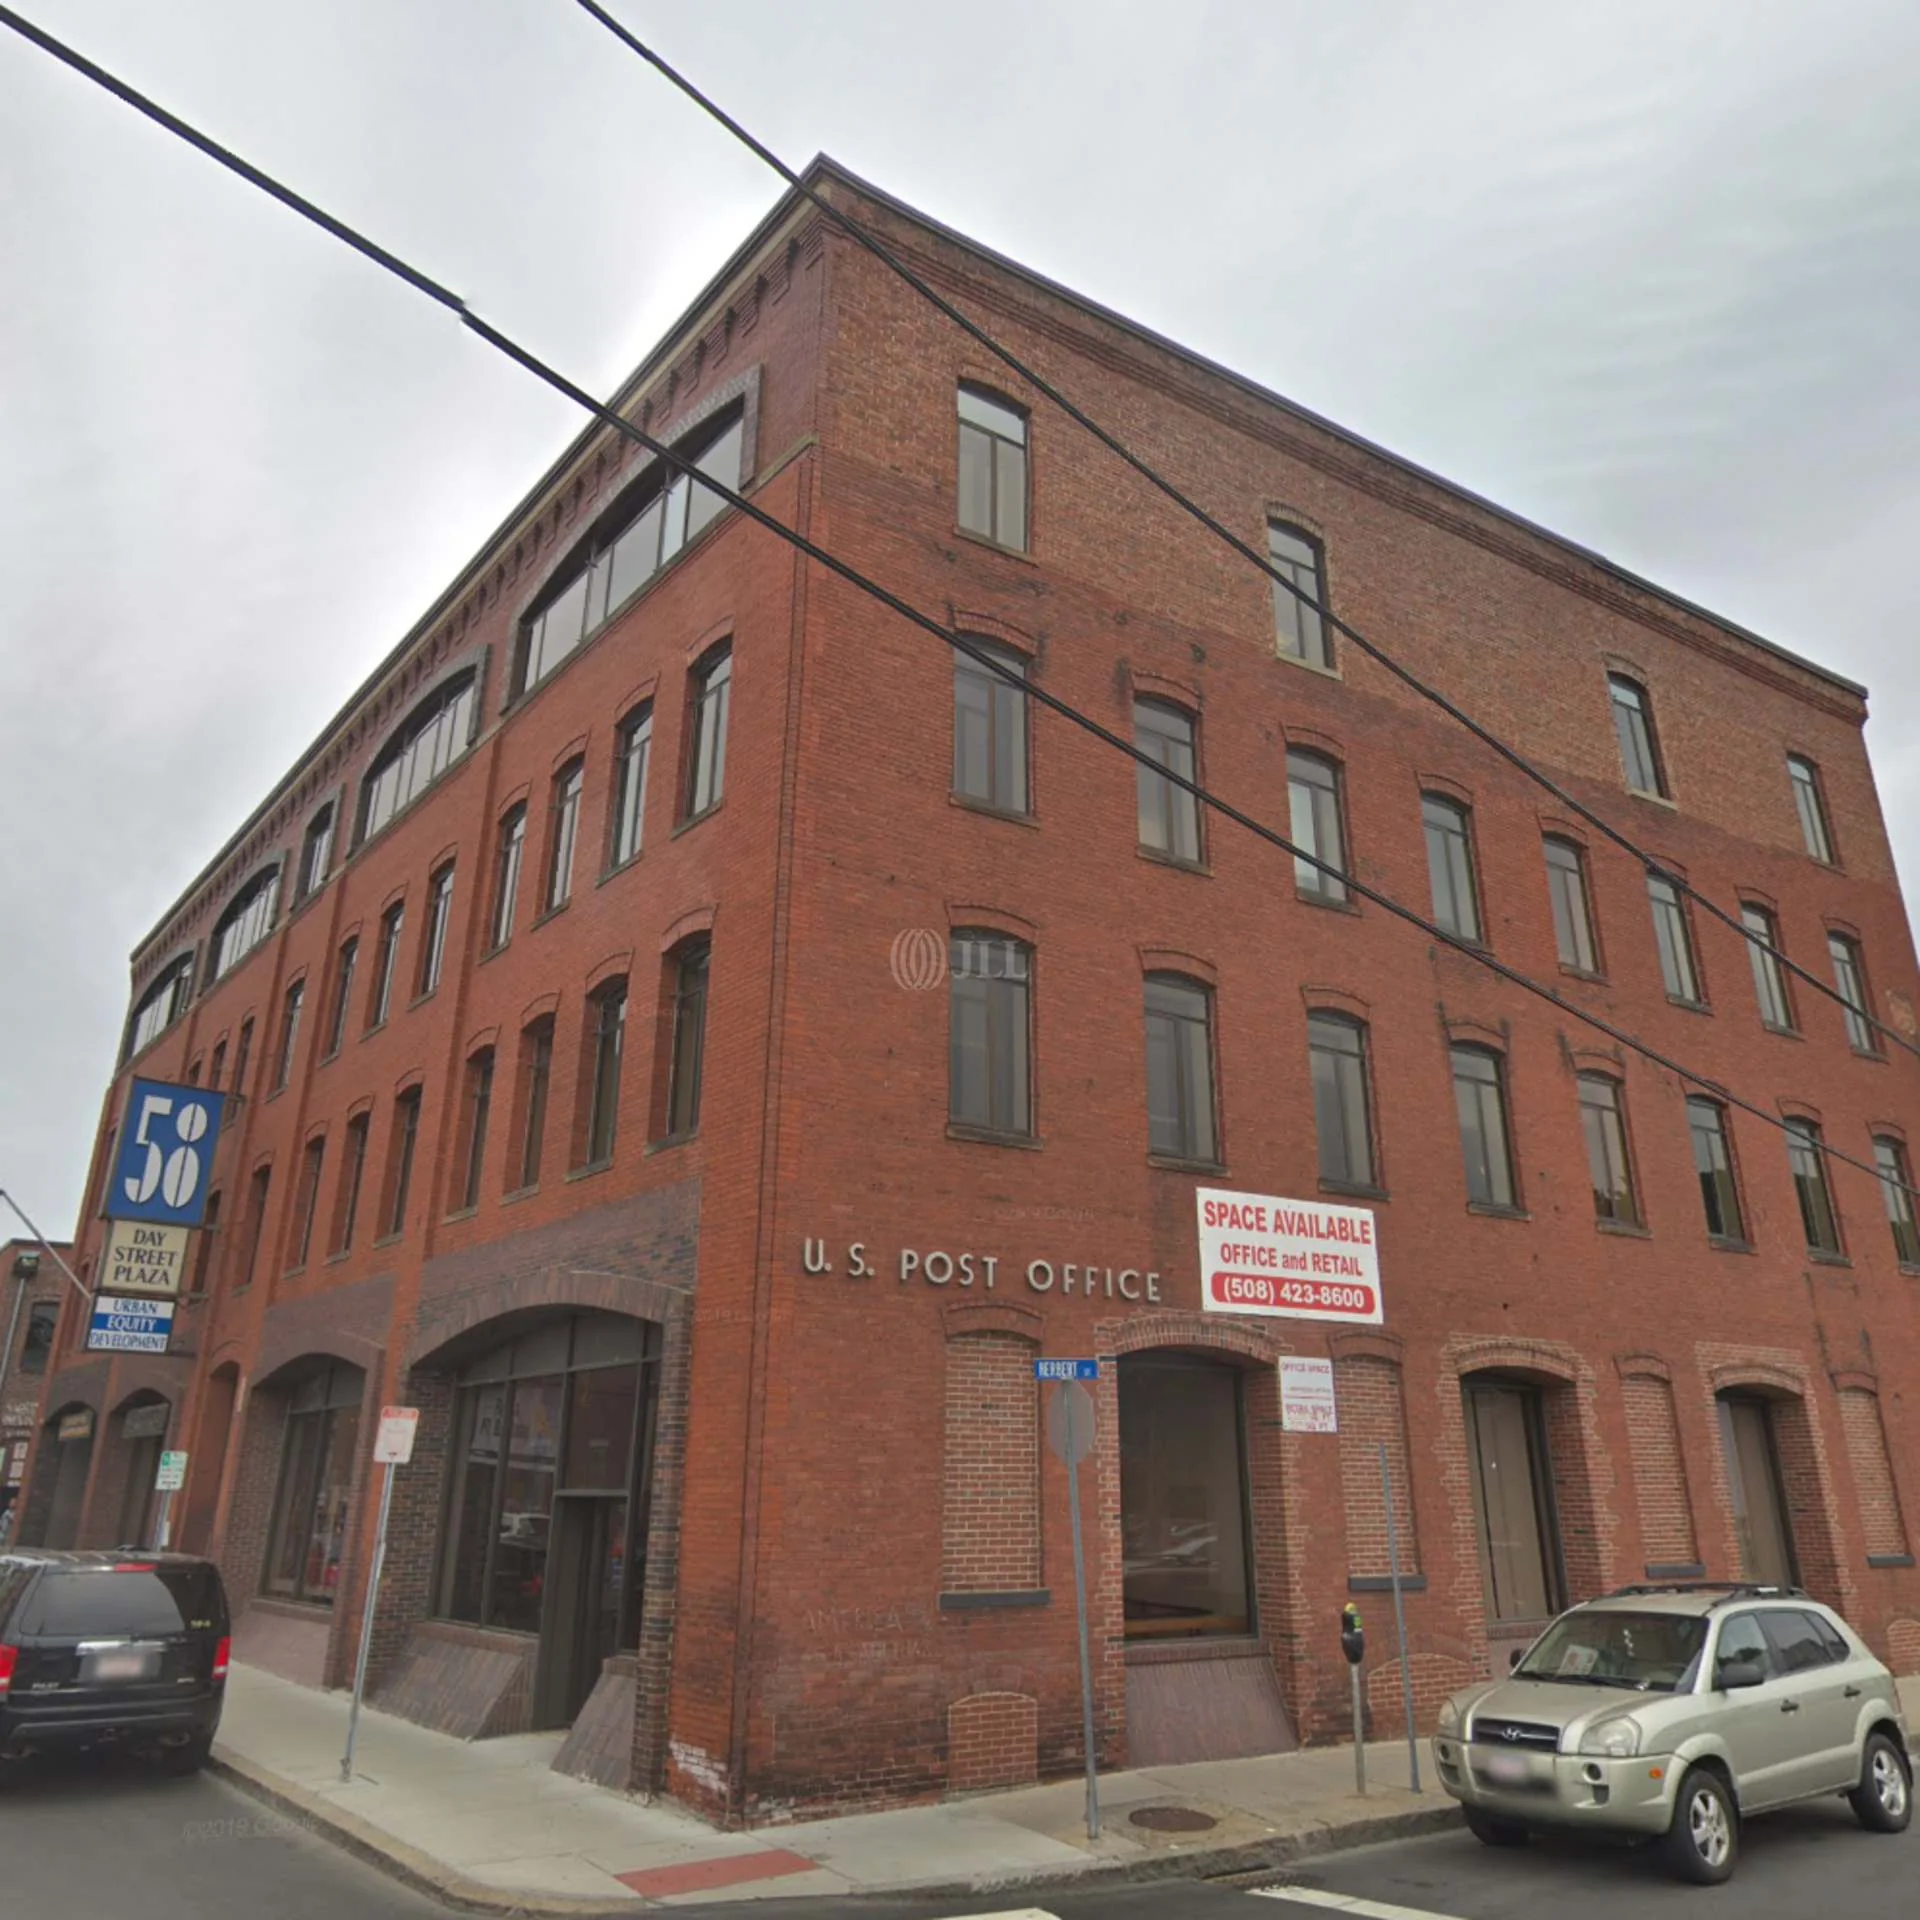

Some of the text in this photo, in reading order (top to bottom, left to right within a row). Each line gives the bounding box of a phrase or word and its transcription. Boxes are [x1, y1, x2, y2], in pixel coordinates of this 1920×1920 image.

[124, 1094, 208, 1208] 58
[1204, 1200, 1371, 1245] SPACE AVAILABLE
[133, 1228, 167, 1246] DAY
[114, 1246, 177, 1266] STREET
[1220, 1243, 1363, 1276] OFFICE and RETAIL
[114, 1266, 169, 1286] PLAZA
[804, 1238, 1162, 1302] U. S. POST OFFICE
[1224, 1277, 1365, 1308] (508) 423-8600
[113, 1300, 158, 1313] URBAN
[106, 1314, 157, 1332] EQUITY
